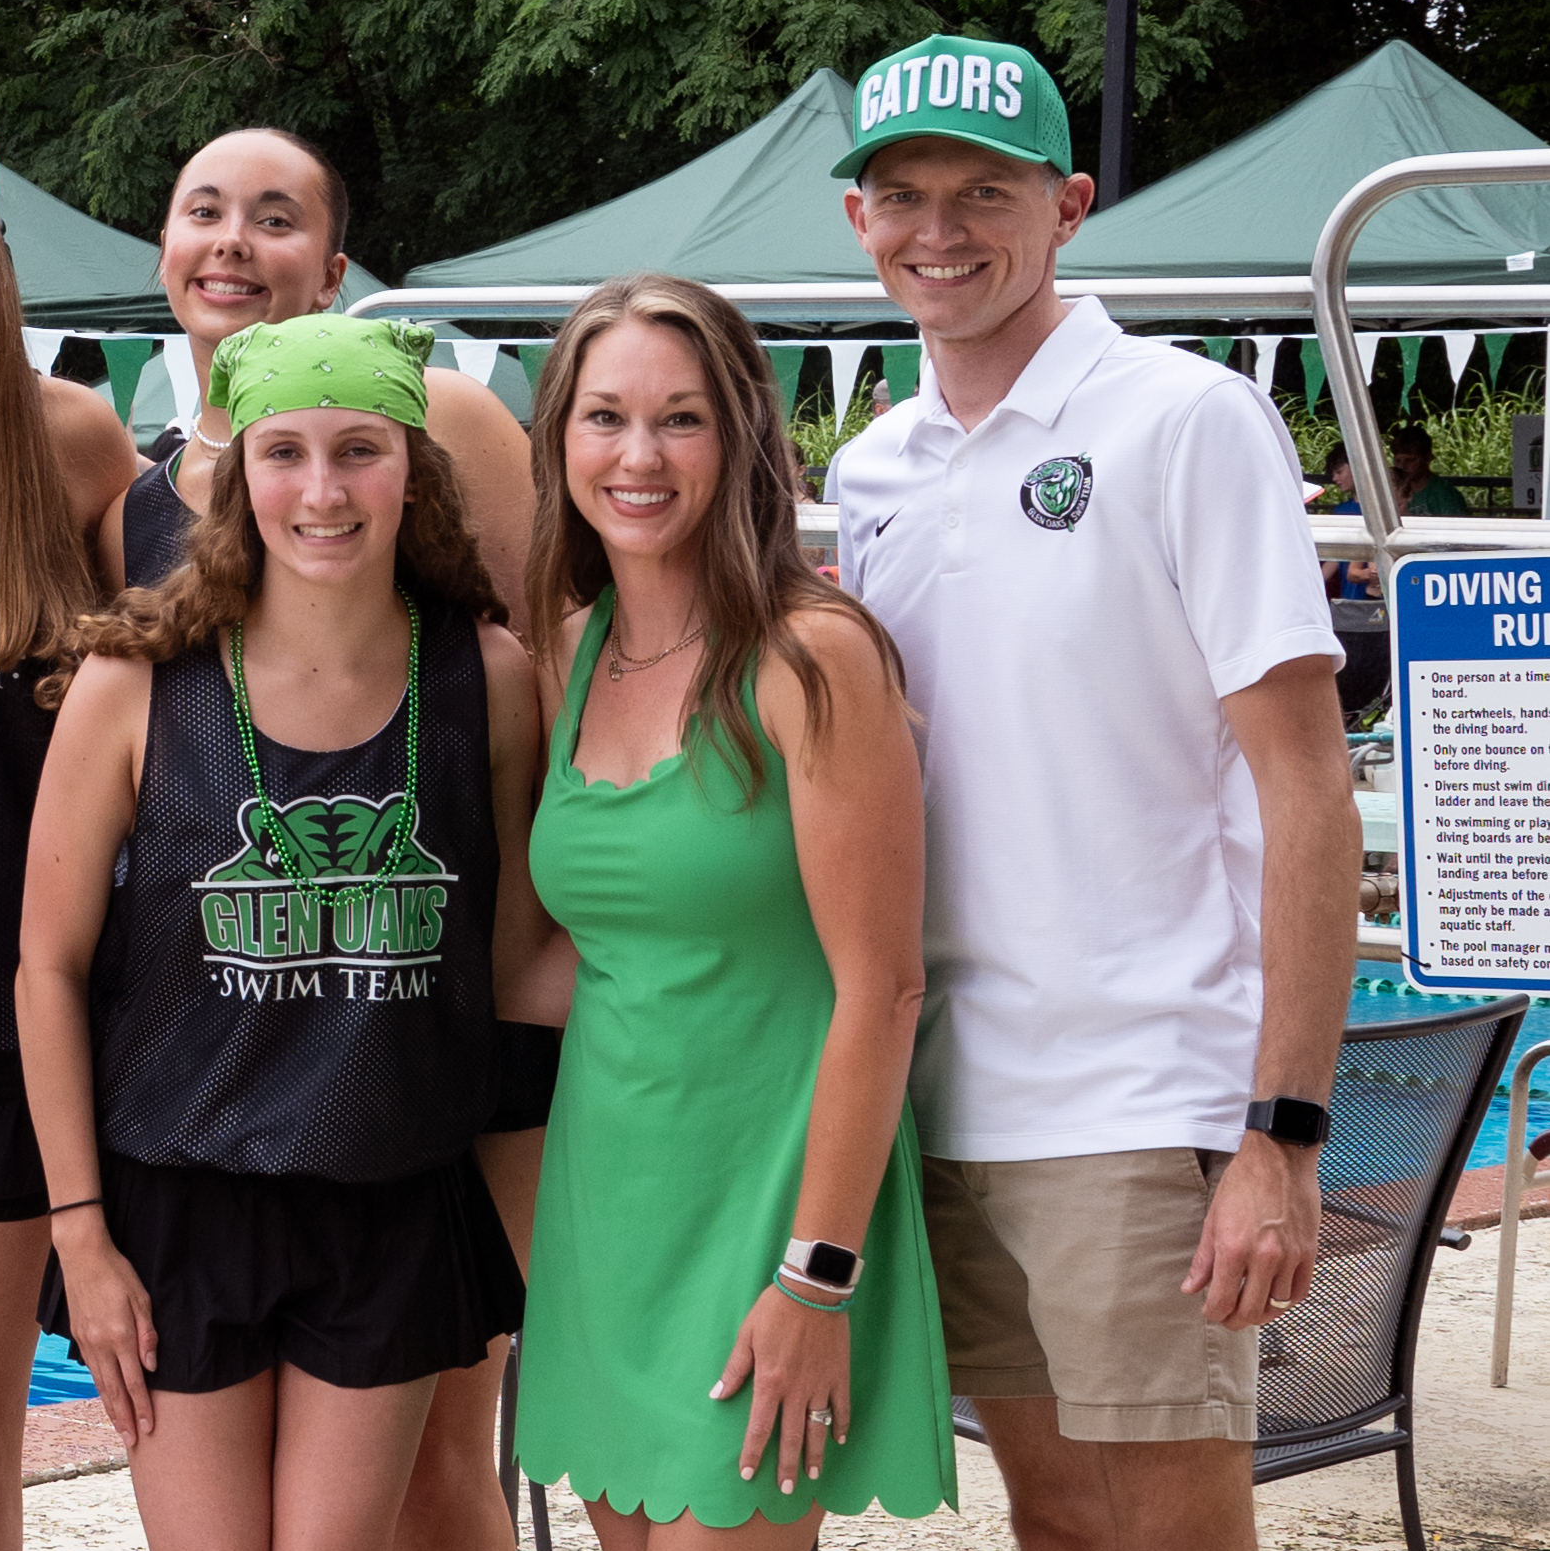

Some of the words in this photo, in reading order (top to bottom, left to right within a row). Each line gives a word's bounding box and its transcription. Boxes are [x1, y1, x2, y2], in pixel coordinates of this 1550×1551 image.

[860, 54, 1023, 132] GATORS
[1424, 570, 1542, 607] DIVING
[1431, 672, 1453, 683] One
[1457, 673, 1495, 685] person
[1499, 672, 1511, 682] at
[1514, 673, 1521, 682] a
[1431, 687, 1467, 698] board.
[1432, 708, 1447, 719] No
[1451, 707, 1516, 719] cartwheels,
[1433, 723, 1451, 734] the
[1454, 723, 1488, 736] diving
[1491, 723, 1528, 734] board.
[1433, 744, 1457, 757] Only
[1461, 746, 1481, 755] one
[1485, 744, 1526, 755] bounce
[1530, 746, 1544, 755] on
[1434, 759, 1470, 770] before
[1473, 759, 1510, 773] diving.
[1435, 780, 1469, 791] Divers
[1472, 781, 1500, 791] must
[1504, 780, 1532, 791] swim
[1435, 795, 1470, 806] ladder
[1474, 796, 1495, 806] and
[1499, 796, 1528, 806] leave
[1532, 796, 1550, 807] the
[1436, 816, 1451, 827] No
[1454, 816, 1511, 830] swimming
[1514, 818, 1525, 827] or
[1436, 832, 1469, 845] diving
[1473, 832, 1511, 843] boards
[1515, 834, 1533, 843] are
[1436, 852, 1462, 863] Wait
[1465, 852, 1491, 863] until
[1495, 853, 1513, 864] the
[1437, 868, 1479, 881] landing
[1483, 870, 1507, 879] area
[1512, 869, 1548, 880] before
[1438, 888, 1507, 902] Adjustments
[1512, 890, 1523, 900] of
[1527, 890, 1545, 901] the
[1439, 906, 1461, 917] may
[1465, 905, 1487, 918] only
[1491, 905, 1505, 916] be
[1508, 906, 1540, 916] made
[201, 892, 320, 957] GLEN
[333, 886, 447, 955] OAKS
[1440, 920, 1481, 932] aquatic
[1485, 920, 1515, 931] staff.
[1440, 940, 1459, 951] The
[1463, 941, 1486, 953] pool
[1491, 943, 1540, 955] manager
[1441, 955, 1474, 967] based
[1478, 958, 1491, 967] on
[1495, 957, 1529, 970] safety
[220, 967, 325, 1002] SWIM
[338, 968, 430, 1001] TEAM
